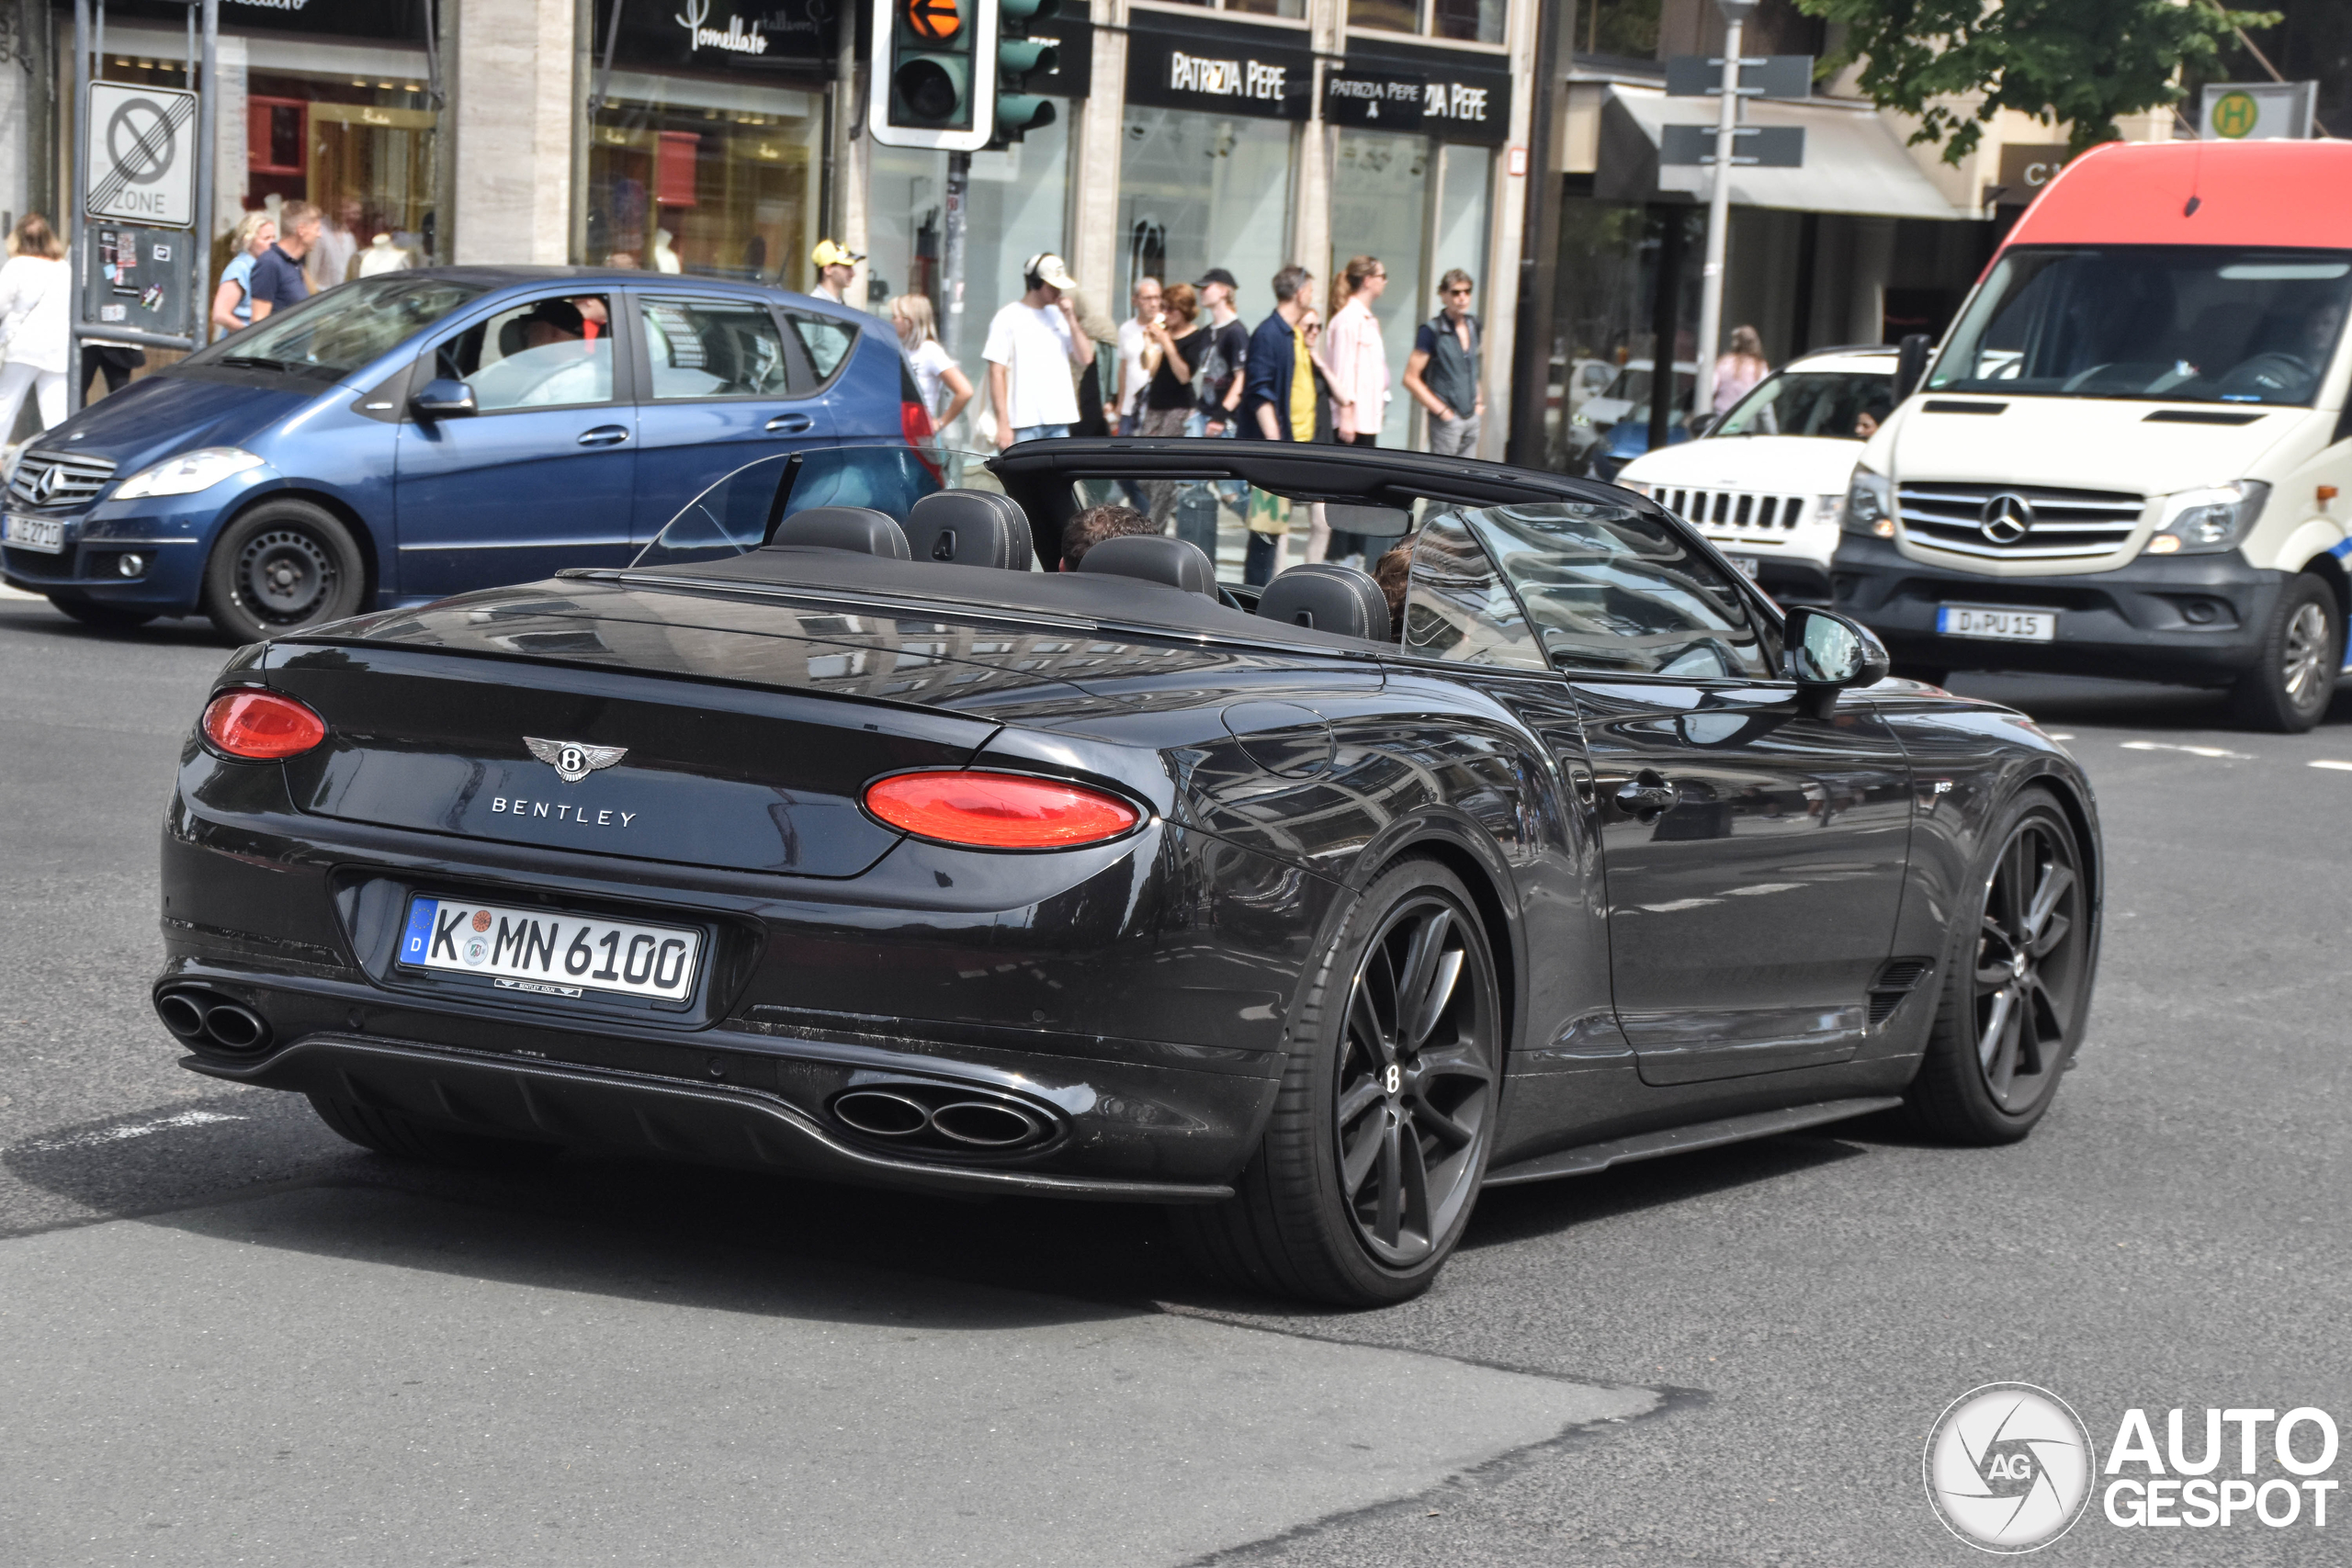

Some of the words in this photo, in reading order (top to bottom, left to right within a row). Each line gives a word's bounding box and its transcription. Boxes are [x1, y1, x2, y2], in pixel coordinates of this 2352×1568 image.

[1171, 51, 1243, 96] PATRIZIA
[1246, 60, 1286, 101] PEPE
[1330, 78, 1385, 100] PATRIZIA
[1386, 82, 1420, 102] PEPE
[1450, 83, 1488, 121] PEPE
[2224, 101, 2247, 128] H
[113, 189, 165, 214] ZONE
[1959, 612, 1972, 631] D
[1984, 614, 2009, 633] PU
[2013, 616, 2039, 636] 15
[561, 749, 582, 772] B
[492, 797, 637, 828] BENTLEY
[411, 938, 421, 953] D
[431, 909, 468, 962] K
[492, 916, 560, 972] MN
[564, 926, 687, 989] 6100
[518, 983, 540, 991] BENTLEY
[1386, 1065, 1399, 1093] B
